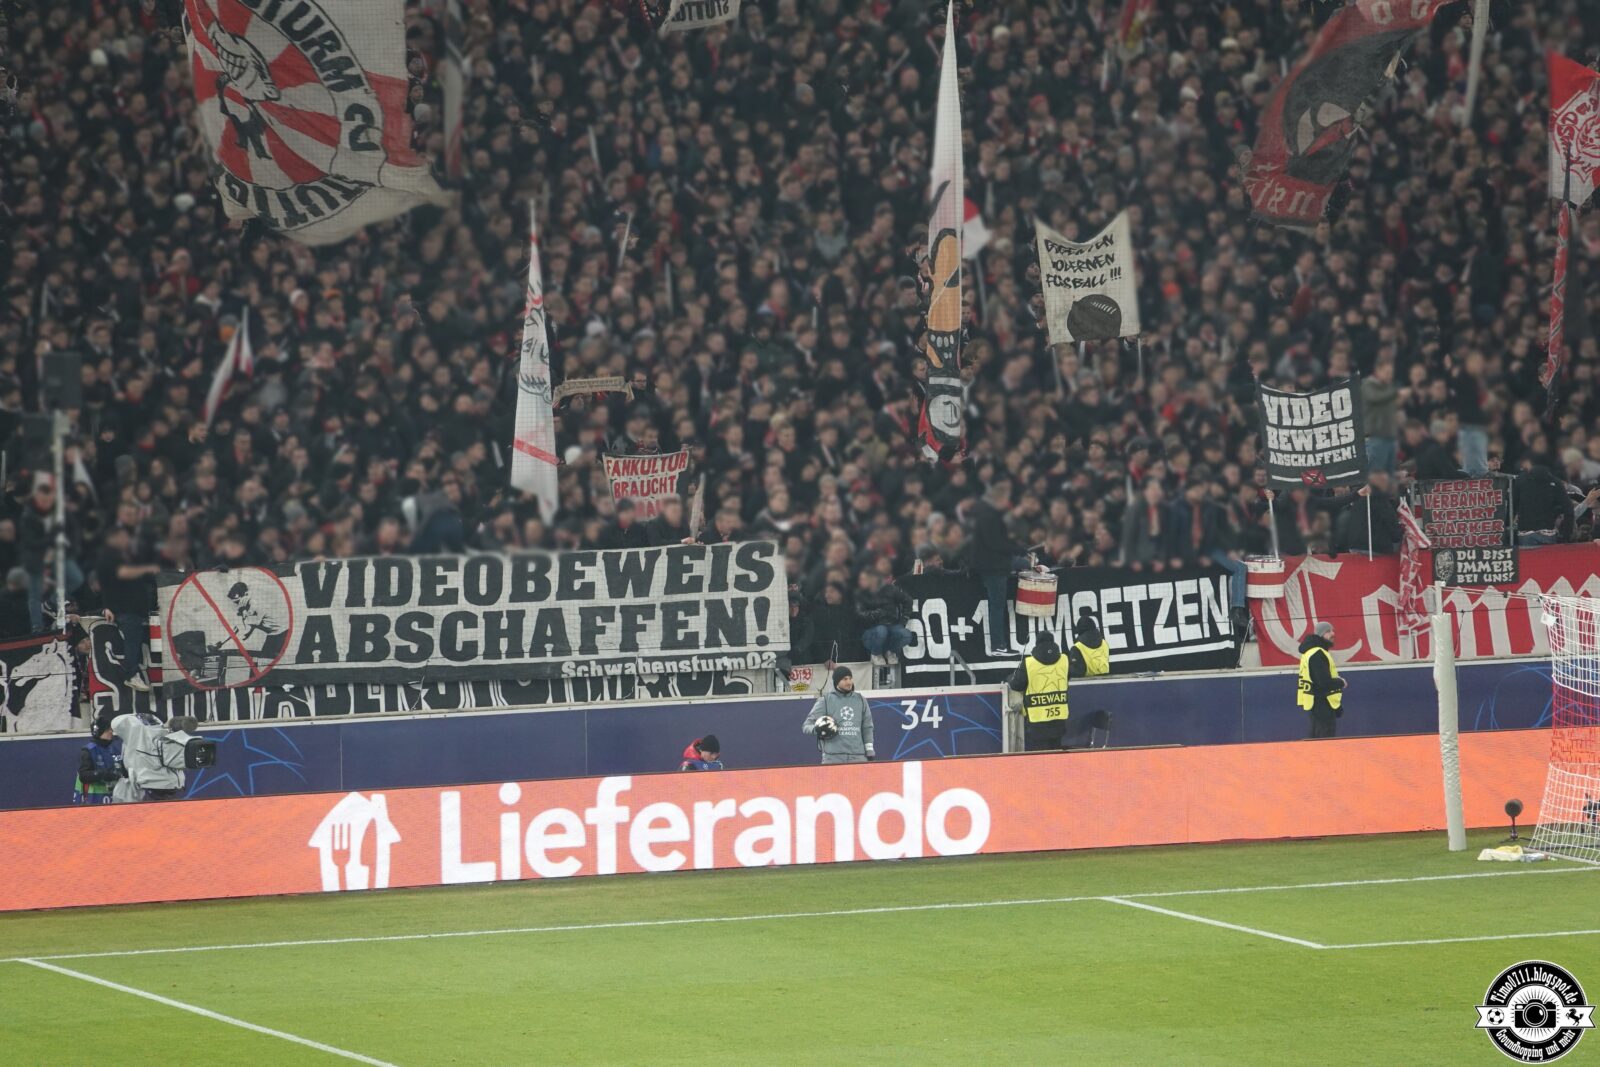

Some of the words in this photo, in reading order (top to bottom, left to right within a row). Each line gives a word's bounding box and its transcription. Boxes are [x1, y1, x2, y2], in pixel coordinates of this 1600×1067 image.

[1262, 387, 1353, 427] VIDEO
[1266, 419, 1355, 452] BEWEIS
[606, 451, 688, 477] FANKULTUR
[1269, 444, 1357, 467] ABSCHAFFEN!
[613, 475, 677, 499] BRAUCHT
[1431, 478, 1494, 494] JEDER
[1423, 488, 1503, 510] VERBANNTE
[1432, 506, 1497, 522] KEHRT
[1456, 549, 1476, 561] DU
[1483, 548, 1513, 560] BIST
[1456, 560, 1514, 573] IMMER
[299, 540, 777, 609] VIDEOBEWEIS
[1457, 574, 1478, 583] BEI
[1483, 572, 1515, 583] UNS!
[1007, 574, 1234, 654] UMSETZEN
[295, 595, 770, 664] ABSCHAFFEN!
[560, 650, 778, 679] Schwabensturm02
[1030, 692, 1067, 706] STEWAR
[900, 698, 944, 731] 34
[1045, 706, 1061, 718] 755
[439, 761, 992, 884] Lieferando
